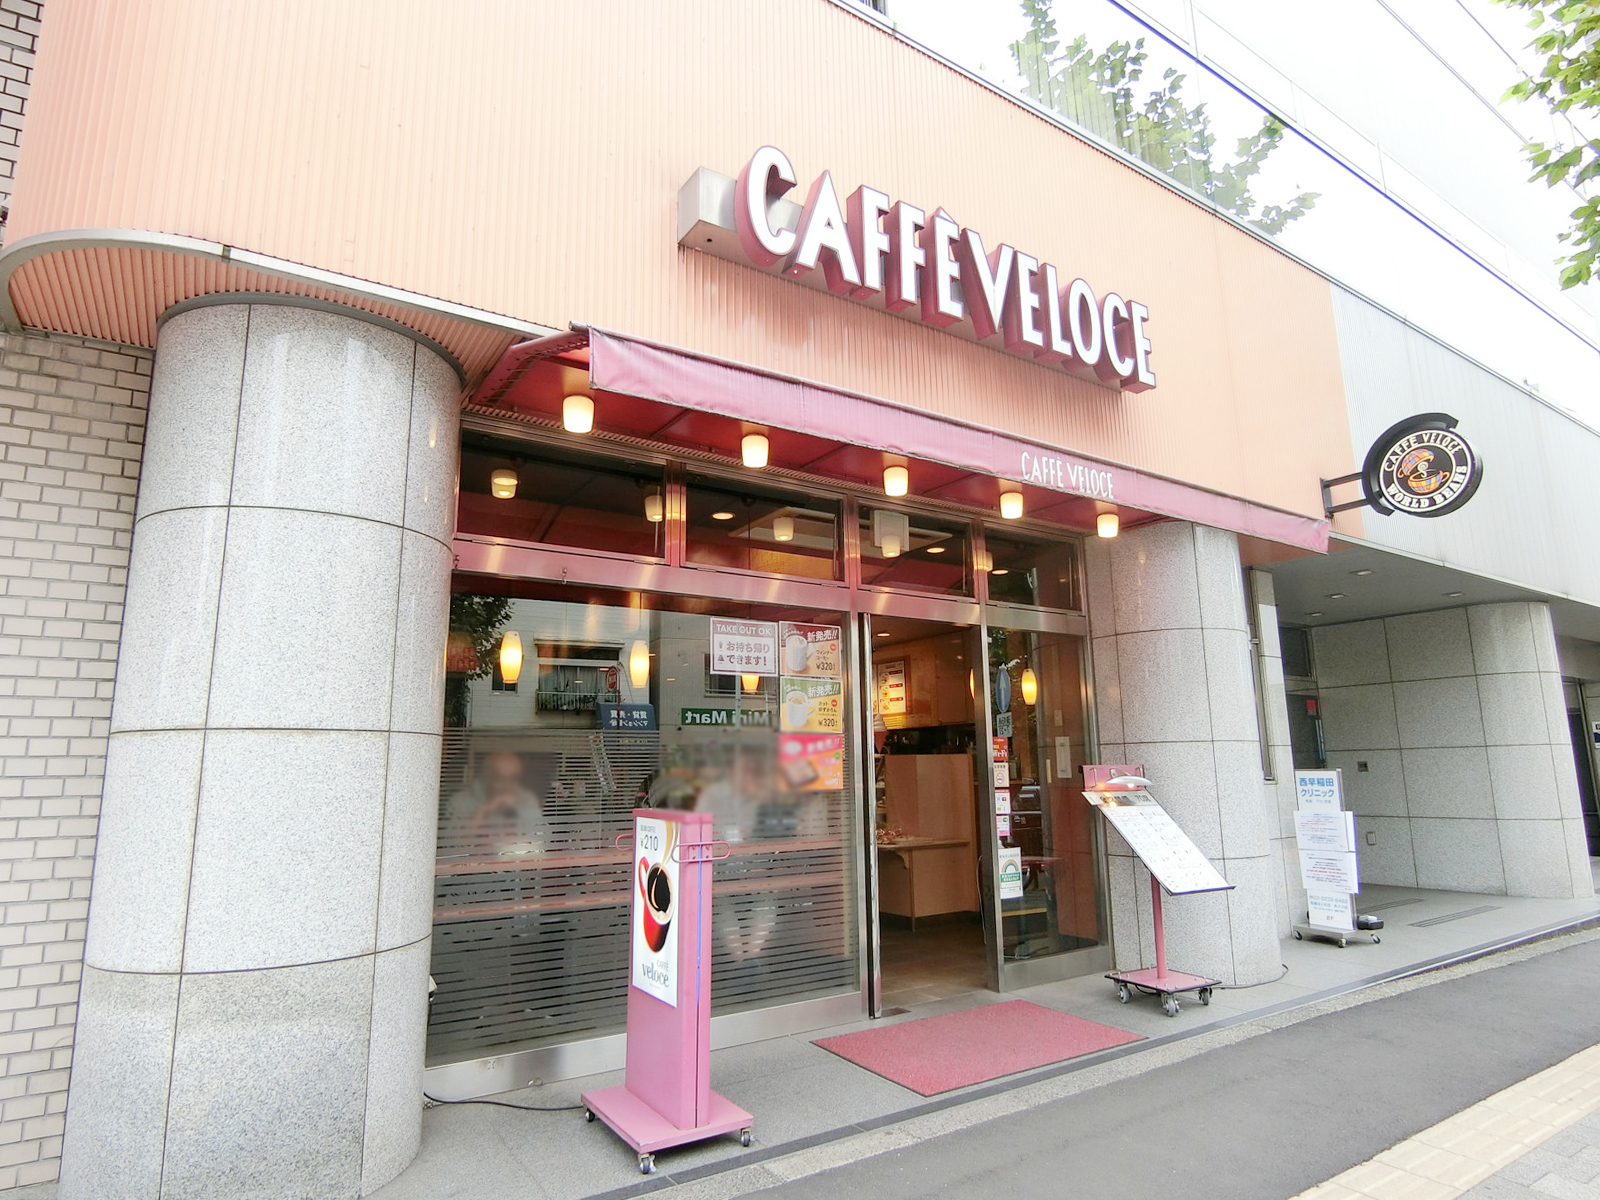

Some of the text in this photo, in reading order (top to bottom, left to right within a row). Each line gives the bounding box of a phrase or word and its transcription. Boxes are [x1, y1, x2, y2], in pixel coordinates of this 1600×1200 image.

[963, 228, 1156, 391] VELOCE
[1422, 432, 1463, 455] VELOCE
[1066, 462, 1114, 499] VELOCE
[1386, 465, 1467, 508] WORLD BEANS
[716, 623, 737, 633] TAKE
[738, 625, 757, 635] OUT
[758, 627, 772, 636] OK
[726, 641, 770, 654] お持ち帰り
[1299, 777, 1335, 787] 西早稲田
[1300, 788, 1335, 798] クリニック
[642, 962, 669, 988] veloce
